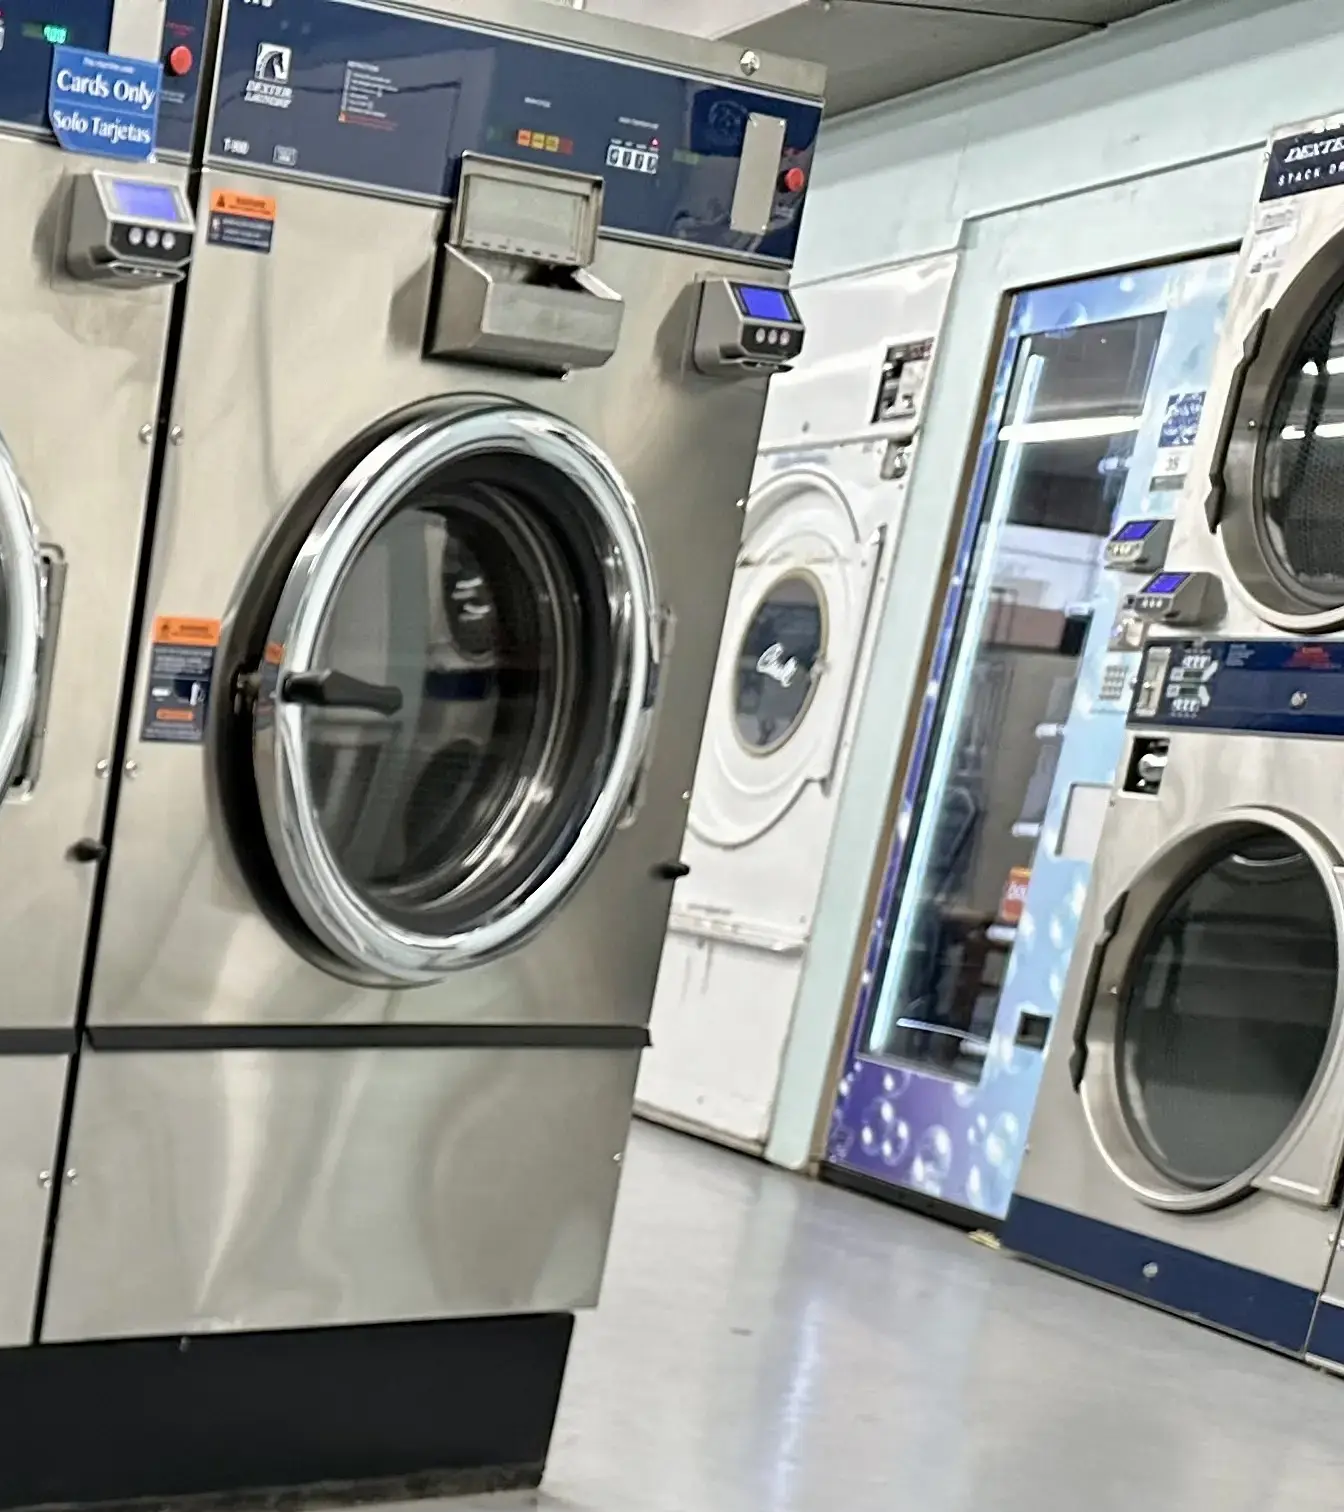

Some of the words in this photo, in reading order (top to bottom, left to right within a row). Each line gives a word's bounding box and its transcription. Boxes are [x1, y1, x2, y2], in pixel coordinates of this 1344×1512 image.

[56, 67, 110, 99] Cards
[113, 78, 155, 111] Only
[52, 109, 88, 134] Solo
[91, 115, 151, 144] Tarjetas
